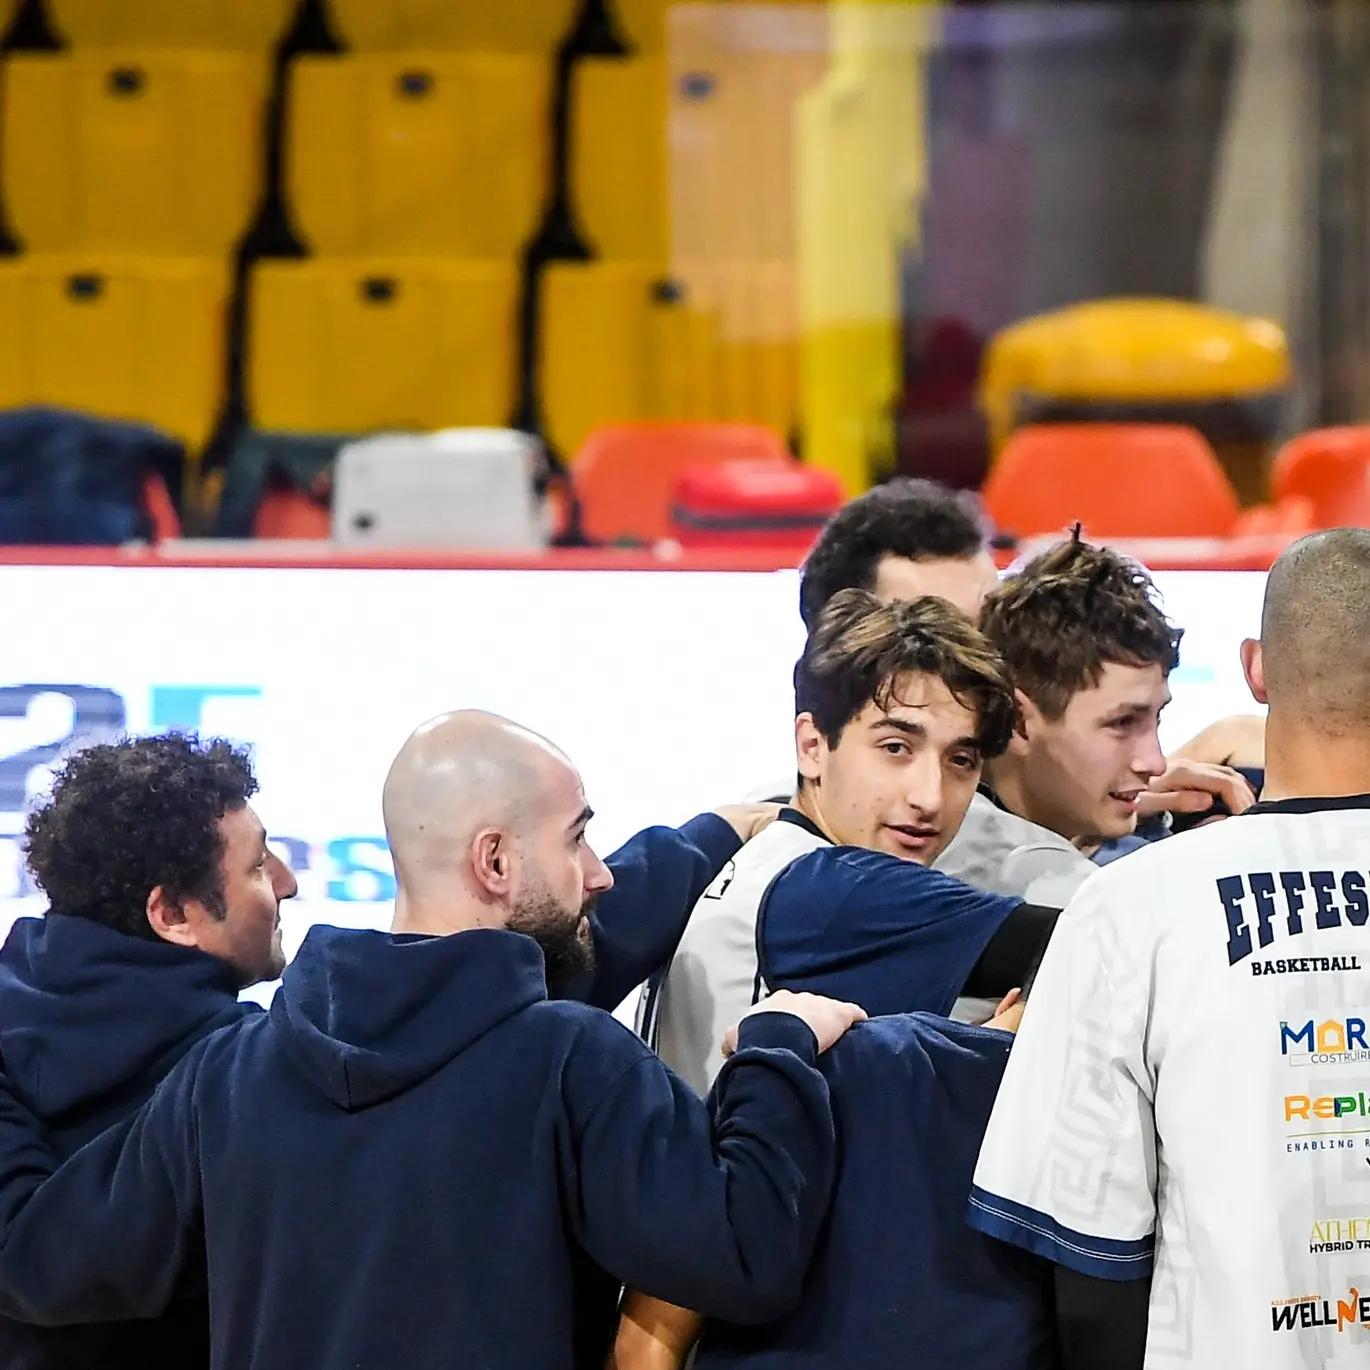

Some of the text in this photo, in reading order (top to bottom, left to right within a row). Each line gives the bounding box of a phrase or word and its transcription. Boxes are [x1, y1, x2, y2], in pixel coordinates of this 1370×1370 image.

[1251, 956, 1361, 976] BASKETBALL
[1286, 1141, 1354, 1153] ENABLING
[1309, 1240, 1354, 1254] HYBRID
